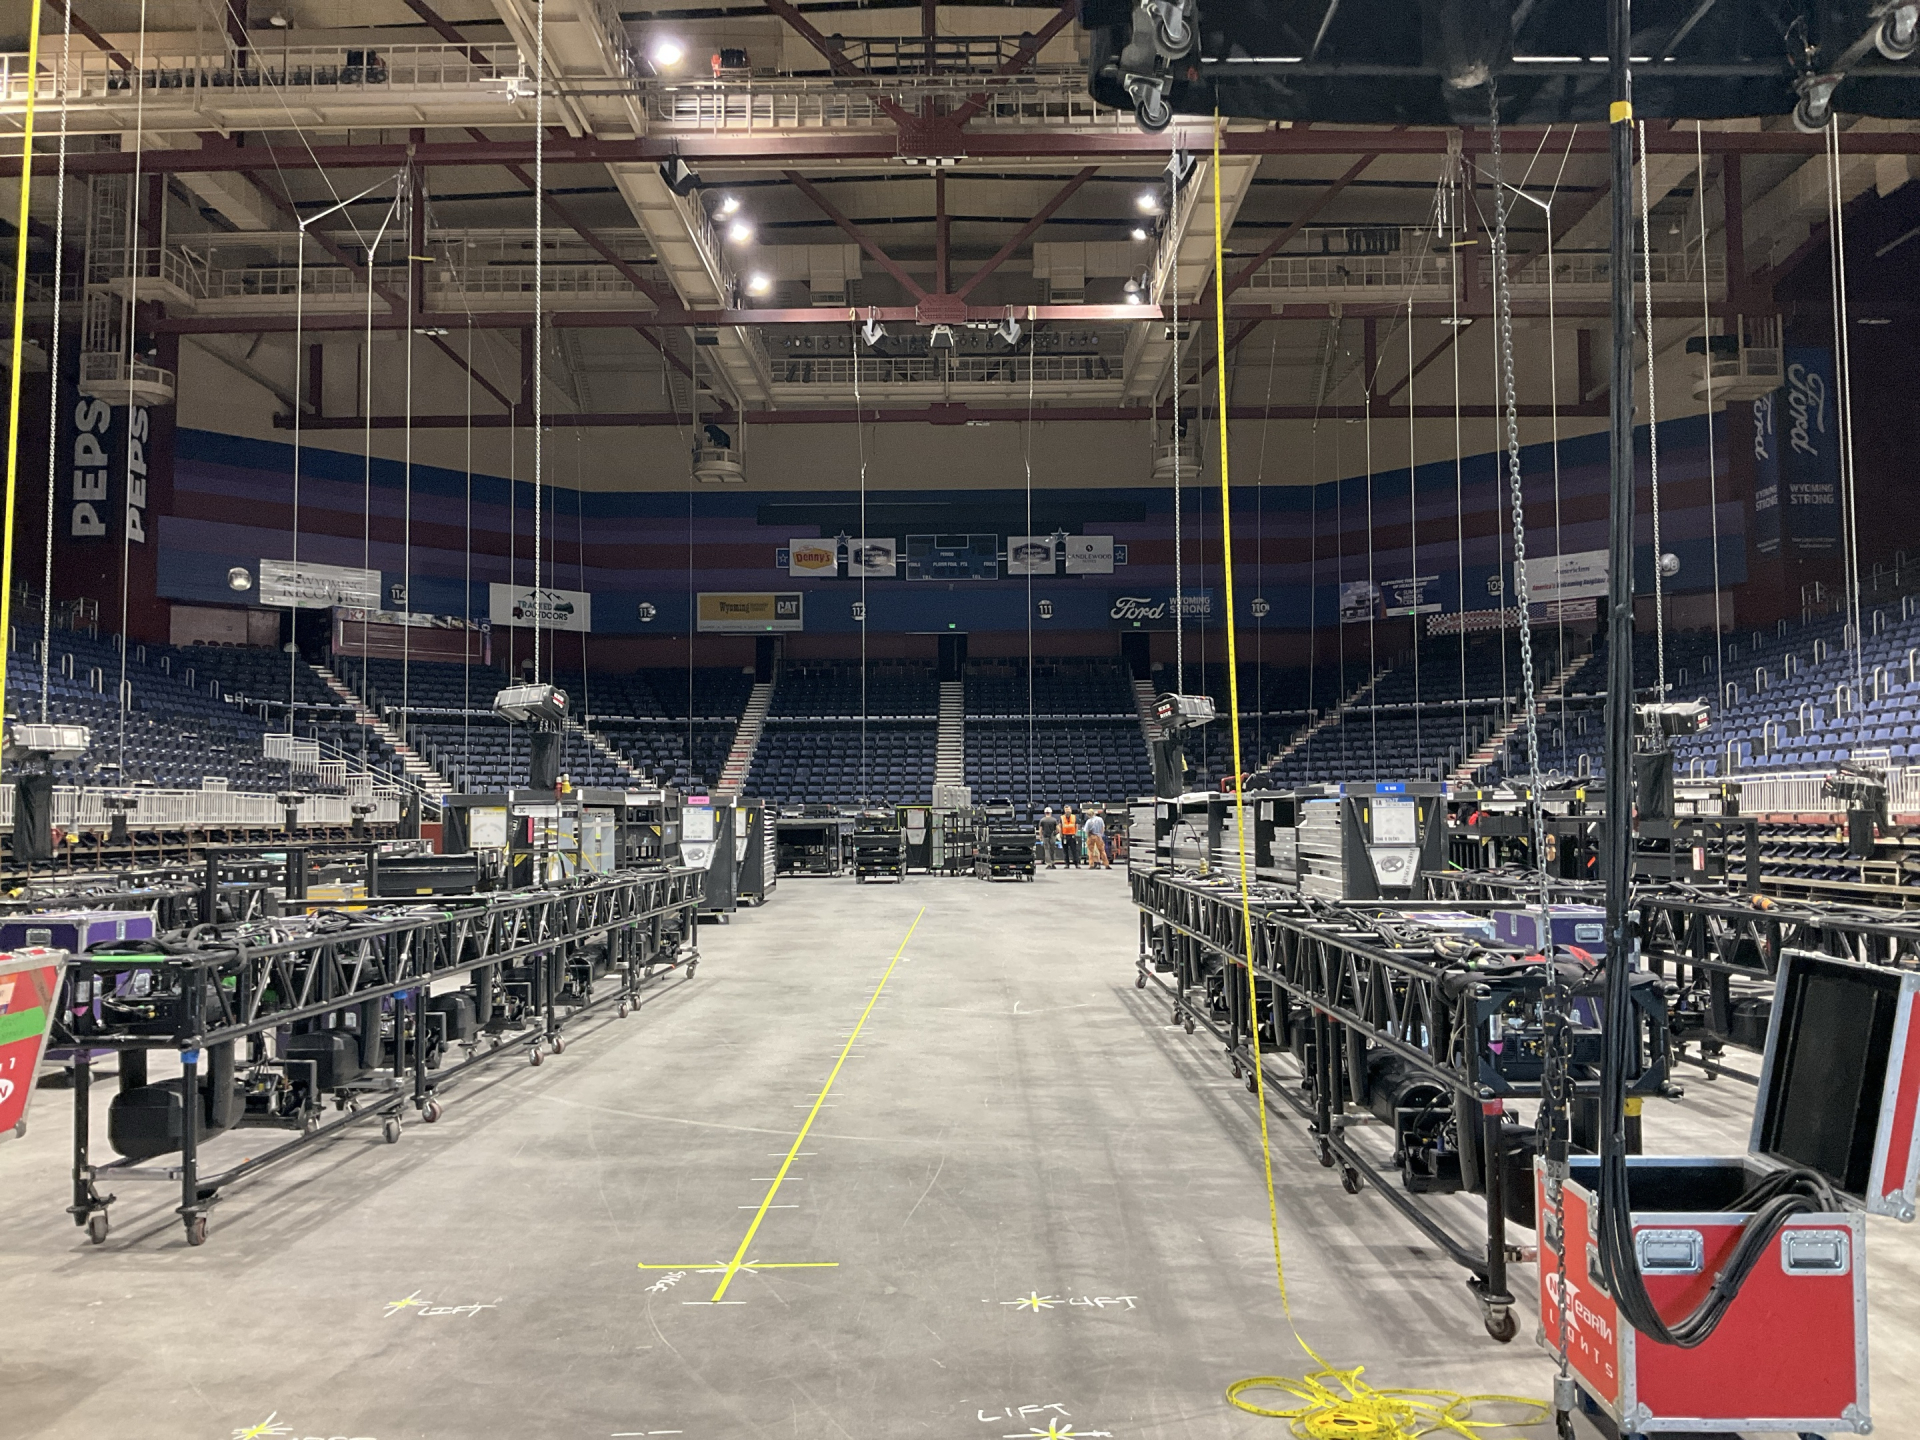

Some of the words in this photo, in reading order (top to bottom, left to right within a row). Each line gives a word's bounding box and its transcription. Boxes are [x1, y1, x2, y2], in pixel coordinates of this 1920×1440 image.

[1788, 483, 1834, 493] WYOMING
[1789, 494, 1834, 504] STRONG
[795, 552, 831, 565] Denny's
[391, 589, 406, 599] 114
[776, 601, 798, 614] CAT
[1110, 597, 1166, 619] Ford
[977, 1402, 1072, 1423] LIFT
